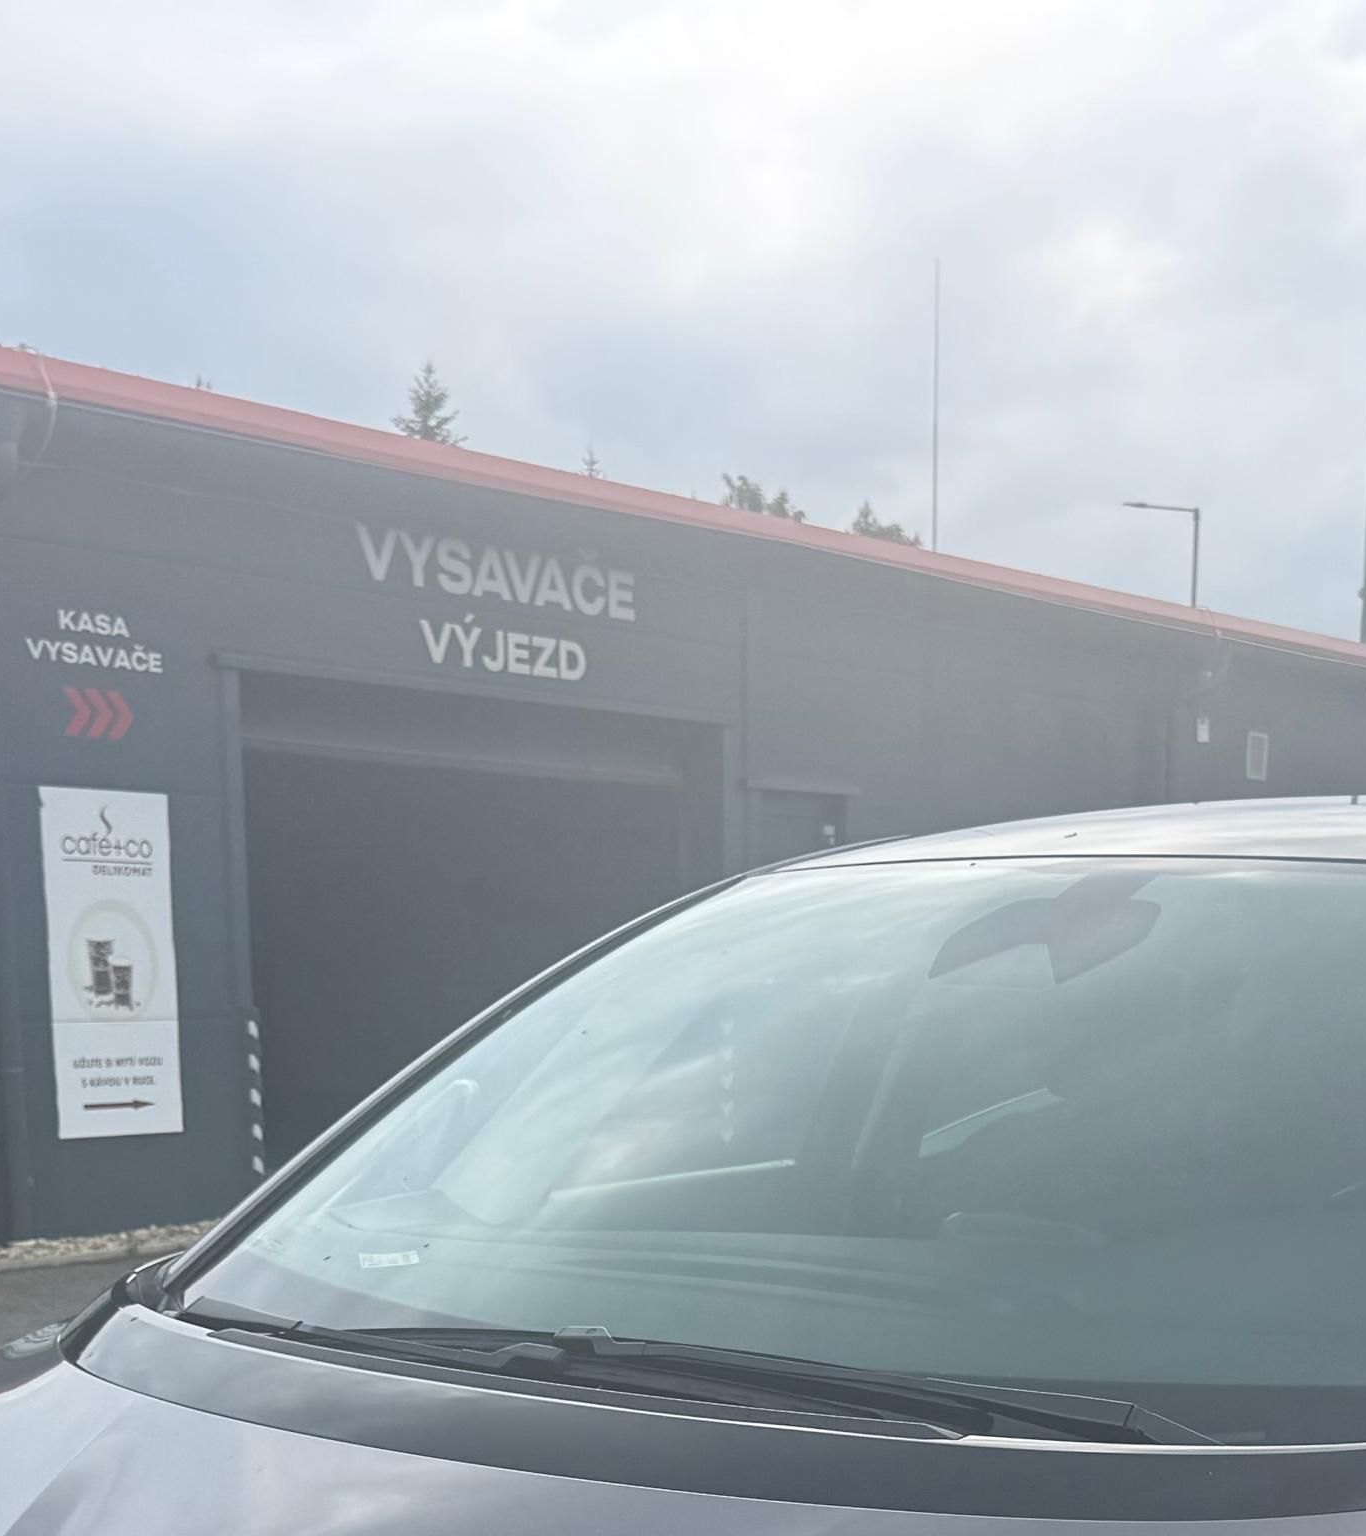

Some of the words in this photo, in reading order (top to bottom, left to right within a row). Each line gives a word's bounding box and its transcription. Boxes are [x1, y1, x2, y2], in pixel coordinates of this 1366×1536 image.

[356, 523, 636, 622] VYSAVAČE
[58, 609, 130, 638] KASA
[419, 613, 586, 681] VÝJEZD
[25, 637, 163, 673] VYSAVAČE
